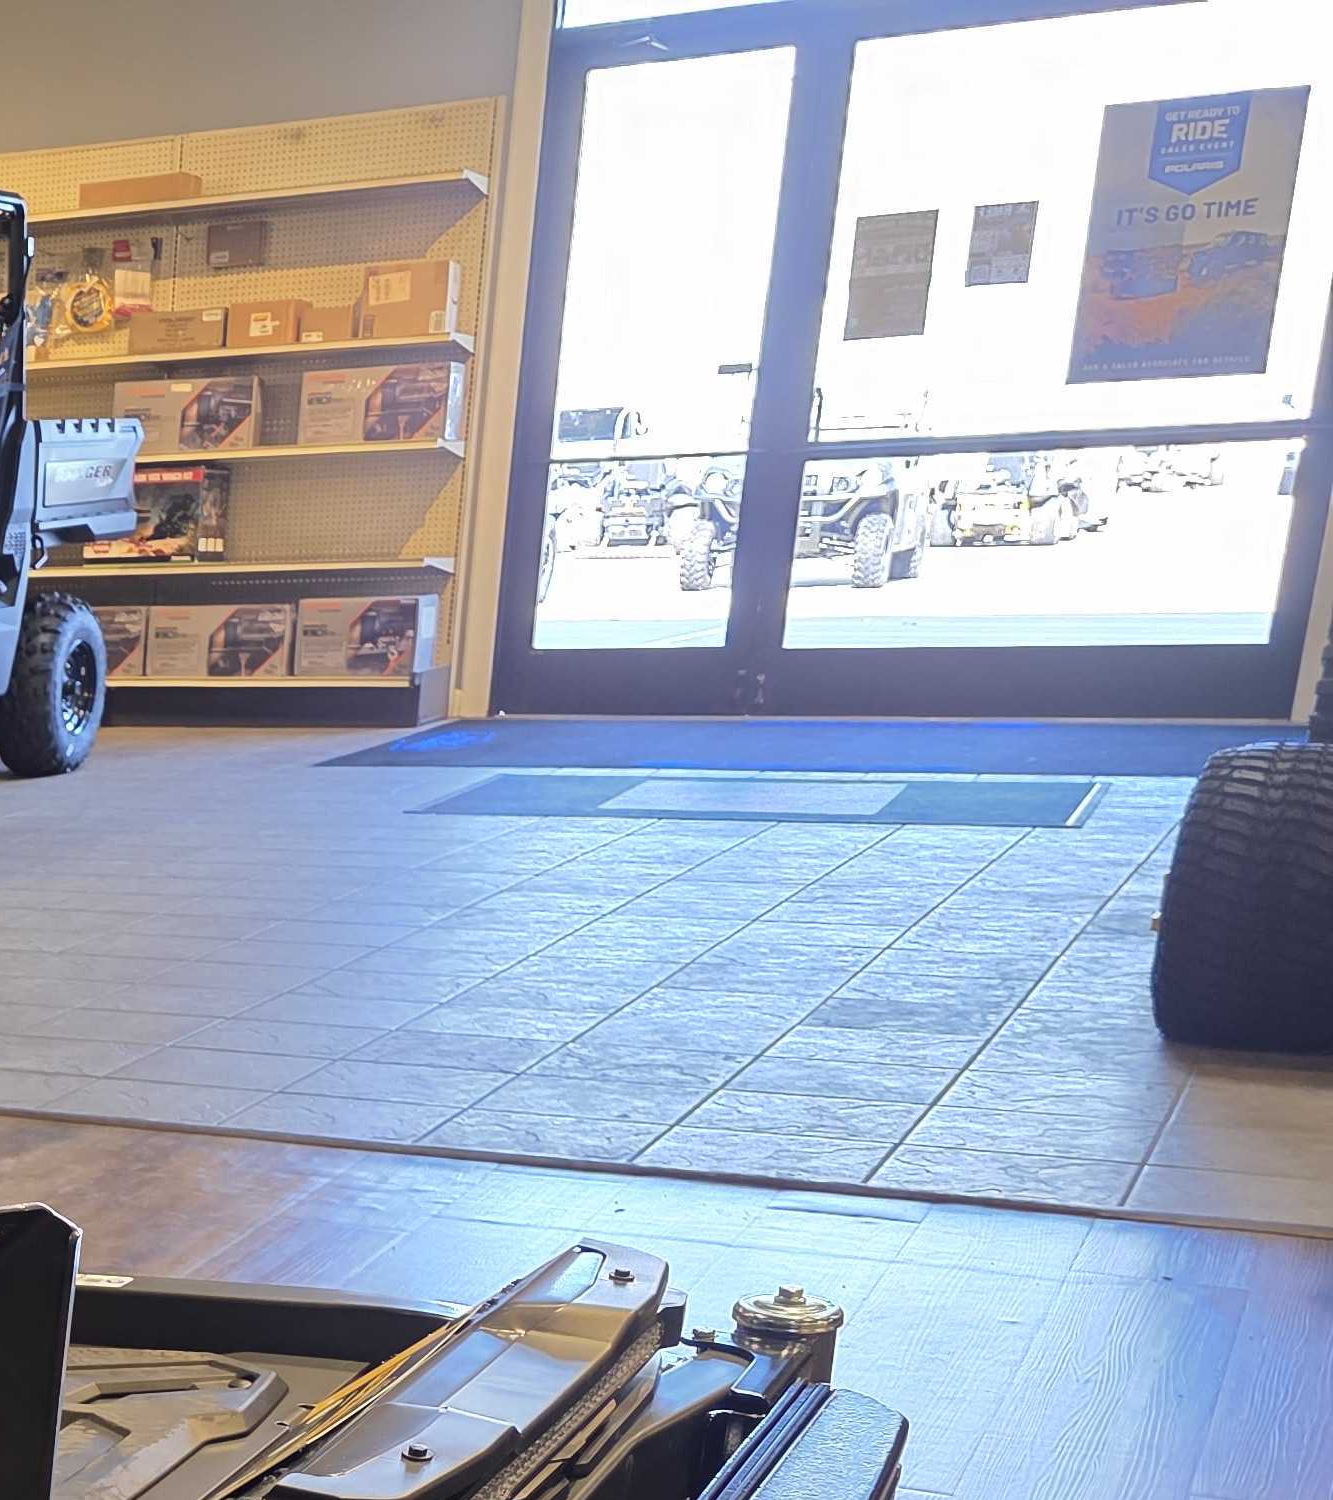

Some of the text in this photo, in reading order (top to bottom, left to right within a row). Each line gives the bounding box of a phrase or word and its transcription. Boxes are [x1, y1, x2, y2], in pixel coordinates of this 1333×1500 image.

[1165, 105, 1240, 122] GET READY TO
[1171, 119, 1230, 143] RIDE
[1199, 141, 1235, 151] EVENT
[1164, 160, 1223, 173] POLARIS
[1117, 198, 1259, 226] IT'S GO TIME
